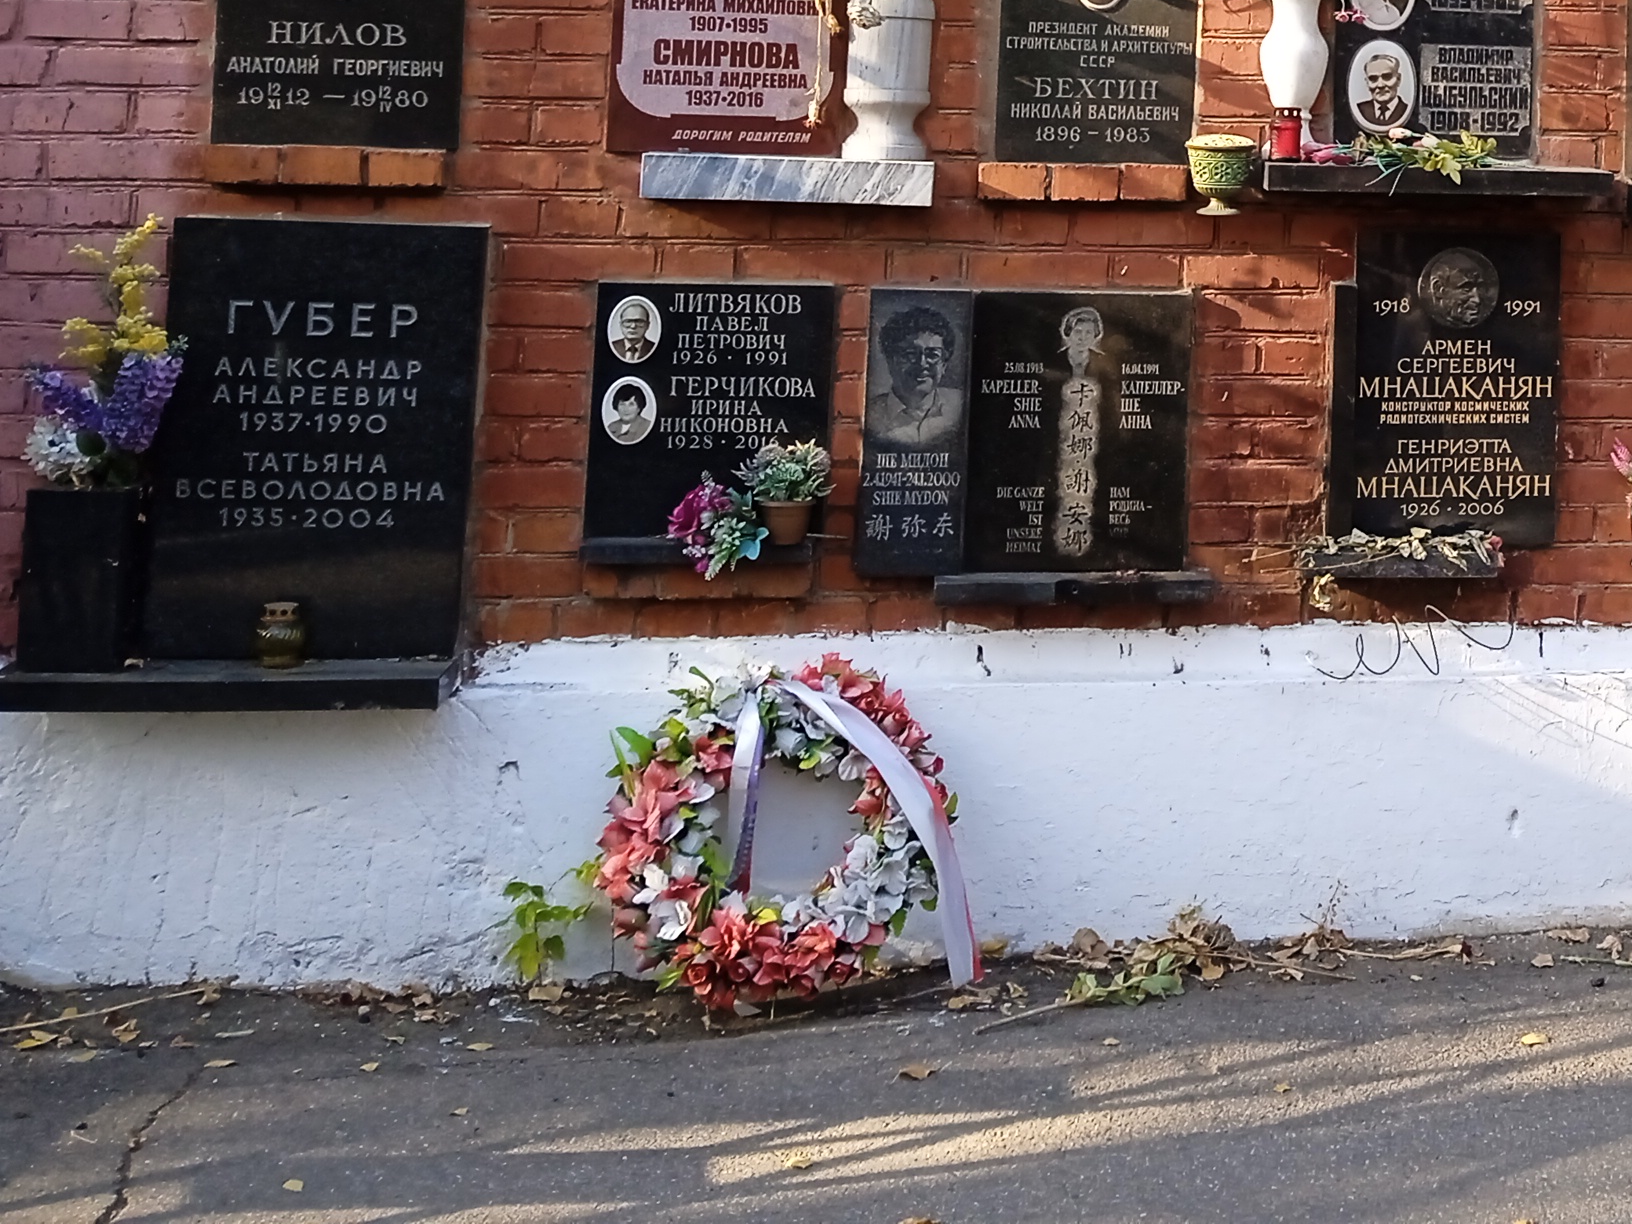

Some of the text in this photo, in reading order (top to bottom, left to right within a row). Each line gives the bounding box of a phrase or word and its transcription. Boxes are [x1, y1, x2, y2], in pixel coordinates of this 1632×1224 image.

[267, 20, 407, 47] НИЛОВ
[1029, 22, 1169, 37] ПРЕЗИДЕНТ АКАДЕМИИ
[654, 38, 800, 69] СМИРНОВА
[1006, 36, 1193, 55] СТРОИТЕЛЬСТВА И АРХИТЕКТУРЫ
[1080, 55, 1116, 68] СССР
[1438, 47, 1514, 65] ВЛАДИМИР
[226, 54, 443, 78] АНАТОЛИЙ ГЕОРГИЕВИЧ
[1431, 66, 1521, 84] ВАСИЛЬЕВИЧ
[643, 70, 807, 89] НАТАЛЬЯ АНДРЕЕВНА
[1033, 77, 1159, 100] БЕХТИН
[1422, 84, 1529, 109] ЦЫБУЛЬСКИЙ
[1010, 102, 1179, 121] НИКОЛАЙ ВАСИЛЬЕВИЧ
[672, 129, 811, 144] ДОРОГИМ РОДИТЕЛЯМ
[669, 293, 802, 314] ЛИТВЯКОВ
[1373, 298, 1541, 316] 1918 1991
[228, 299, 418, 338] ГУБЕР
[696, 316, 768, 331] ПАВЕЛ
[677, 334, 785, 349] ПЕТРОВИЧ
[1422, 340, 1491, 356] АРМЕН
[214, 356, 422, 380] АЛЕКСАНДР
[1397, 358, 1515, 374] СЕРГЕЕВИЧ
[212, 383, 418, 407] АНДРЕЕВИЧ
[670, 376, 816, 398] ГЕРЧИКОВА
[1359, 376, 1552, 400] МНАЦАКАНЯН
[691, 400, 763, 415] ИРИНА
[1014, 398, 1042, 412] SHIE
[1121, 398, 1140, 412] ШЕ
[1382, 400, 1529, 412] КОНСТРУКТОР КОСМИЧЕСКИХ
[660, 417, 789, 434] НИКОНОВНА
[1009, 415, 1041, 429] ANNA
[1119, 415, 1152, 429] АННА
[1380, 413, 1530, 424] РАДИОТЕХНИЧЕСКИХ СИСТЕМ
[1398, 438, 1512, 454] ГЕНРИЭТТА
[242, 451, 387, 474] ТАТЬЯНА
[1385, 456, 1523, 474] ДМИТРИЕВНА
[175, 478, 445, 502] ВСЕВОЛОДОВНА
[1356, 474, 1550, 500] МНАЦАКАНЯН
[873, 490, 950, 505] SHIE MYDON
[1019, 501, 1043, 511] WELT
